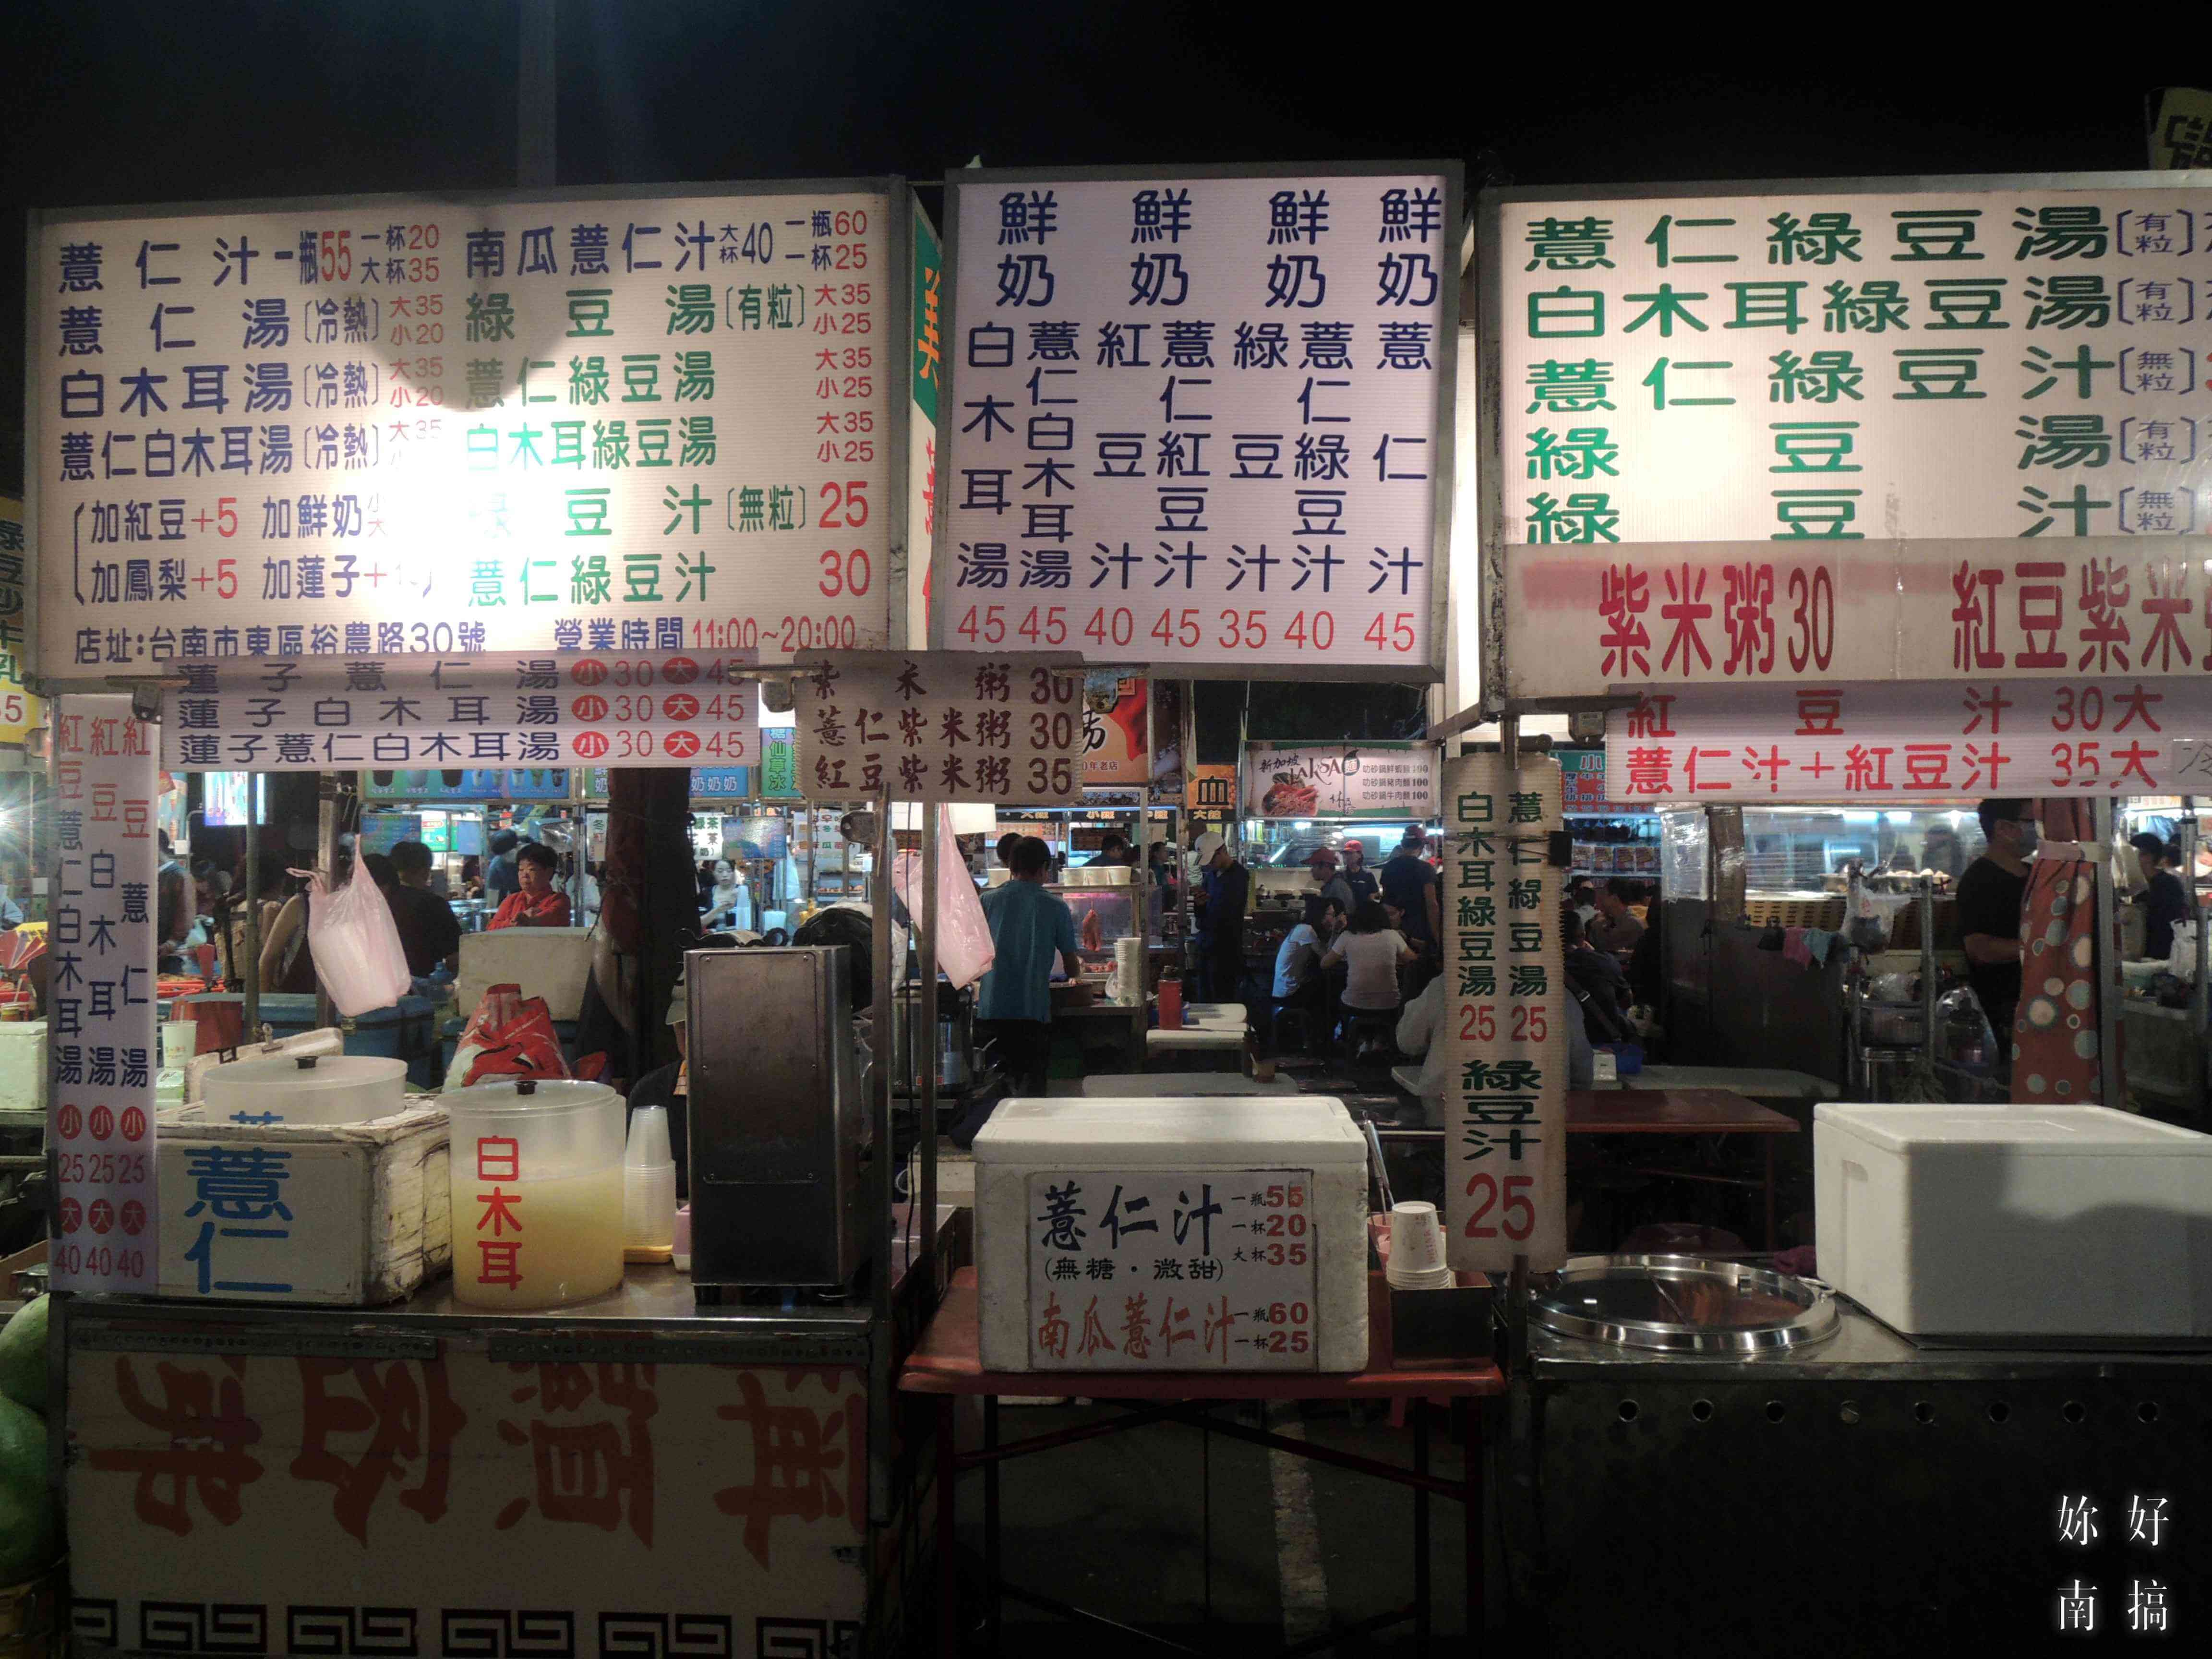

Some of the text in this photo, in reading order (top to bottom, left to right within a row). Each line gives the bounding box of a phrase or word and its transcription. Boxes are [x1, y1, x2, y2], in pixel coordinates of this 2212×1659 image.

[59, 235, 259, 294] 薏仁汁
[466, 220, 715, 278] 南瓜薏仁汁
[1524, 206, 2110, 272] 薏仁綠豆湯
[59, 298, 290, 356] 薏仁湯
[465, 284, 715, 343] 綠豆湯
[1526, 275, 2112, 338] 白木耳綠豆湯
[60, 362, 292, 418] 白木耳湯
[465, 351, 715, 409] 薏仁綠豆湯
[1524, 344, 2115, 414] 薏仁綠豆汁
[60, 425, 292, 481] 薏仁白木耳湯
[467, 416, 716, 470] 白木耳綠豆湯
[1525, 414, 2112, 481] 綠豆湯
[818, 481, 868, 528] 25
[1526, 484, 2112, 545] 綠豆汁
[469, 549, 870, 607] 薏仁綠豆汁 30
[554, 617, 684, 650] 營業時間
[958, 604, 1416, 653] 45 45 40 45 35 40 45
[1952, 556, 2212, 674] 紅豆紫米
[179, 695, 559, 729] 蓮子白木耳湯
[1029, 711, 1072, 750] 30
[180, 731, 560, 764] 蓮子薏仁白木耳湯
[1027, 757, 1072, 795] 35
[1457, 791, 1496, 997] 白木耳綠豆湯
[1460, 1004, 1547, 1043] 25 25
[1462, 1059, 1542, 1161] 綠豆汁
[59, 1154, 144, 1184] 25 25 25
[184, 1146, 292, 1294] 薏仁
[476, 1135, 523, 1291] 白木耳
[1037, 1180, 1223, 1256] 薏仁汁
[1465, 1172, 1535, 1241] 25
[54, 1246, 144, 1278] 40 40 40
